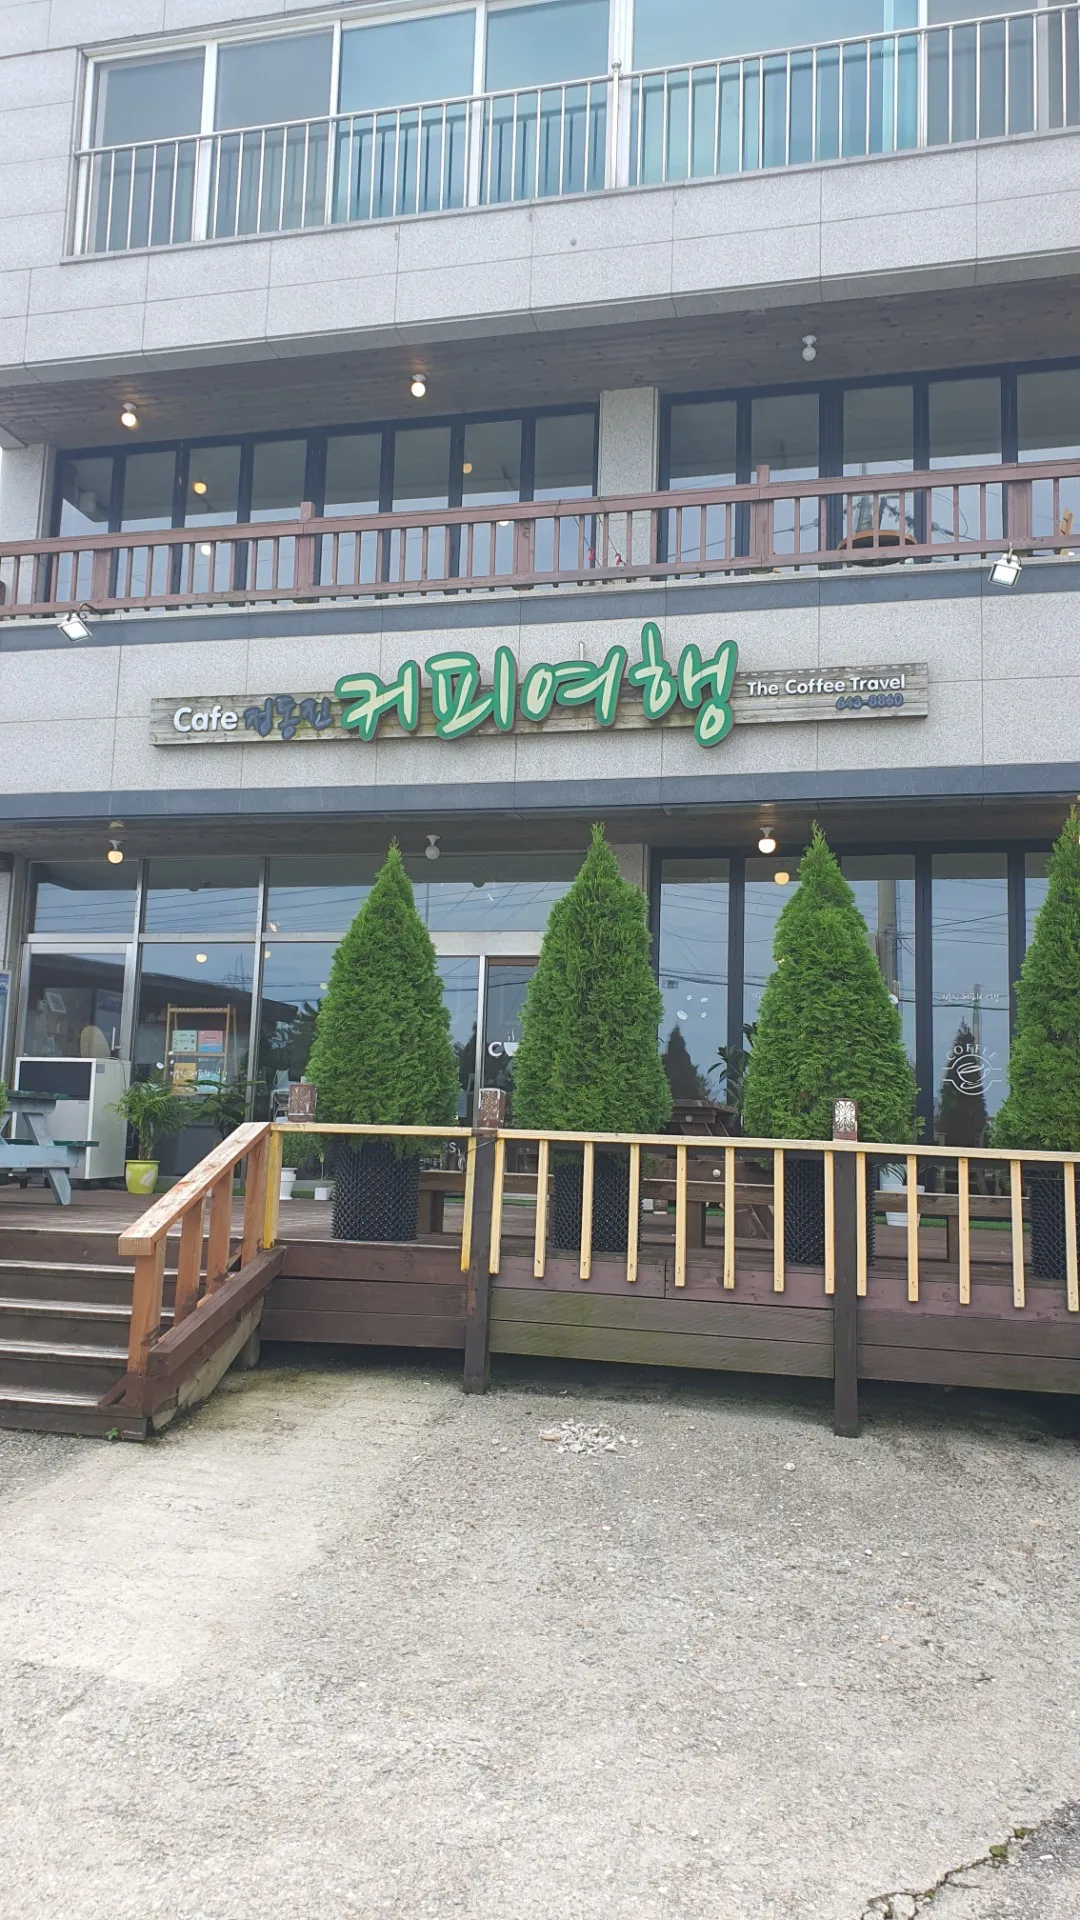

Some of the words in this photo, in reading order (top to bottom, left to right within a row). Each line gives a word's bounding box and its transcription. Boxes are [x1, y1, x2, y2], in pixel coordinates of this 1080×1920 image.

[173, 705, 238, 732] Cafe
[243, 694, 335, 740] 정동진
[334, 622, 739, 747] 커피여행
[747, 681, 779, 696] The
[785, 678, 846, 695] Coffee
[849, 674, 906, 692] Travel
[836, 693, 904, 711] 643-8860
[946, 1043, 998, 1061] COFFEE
